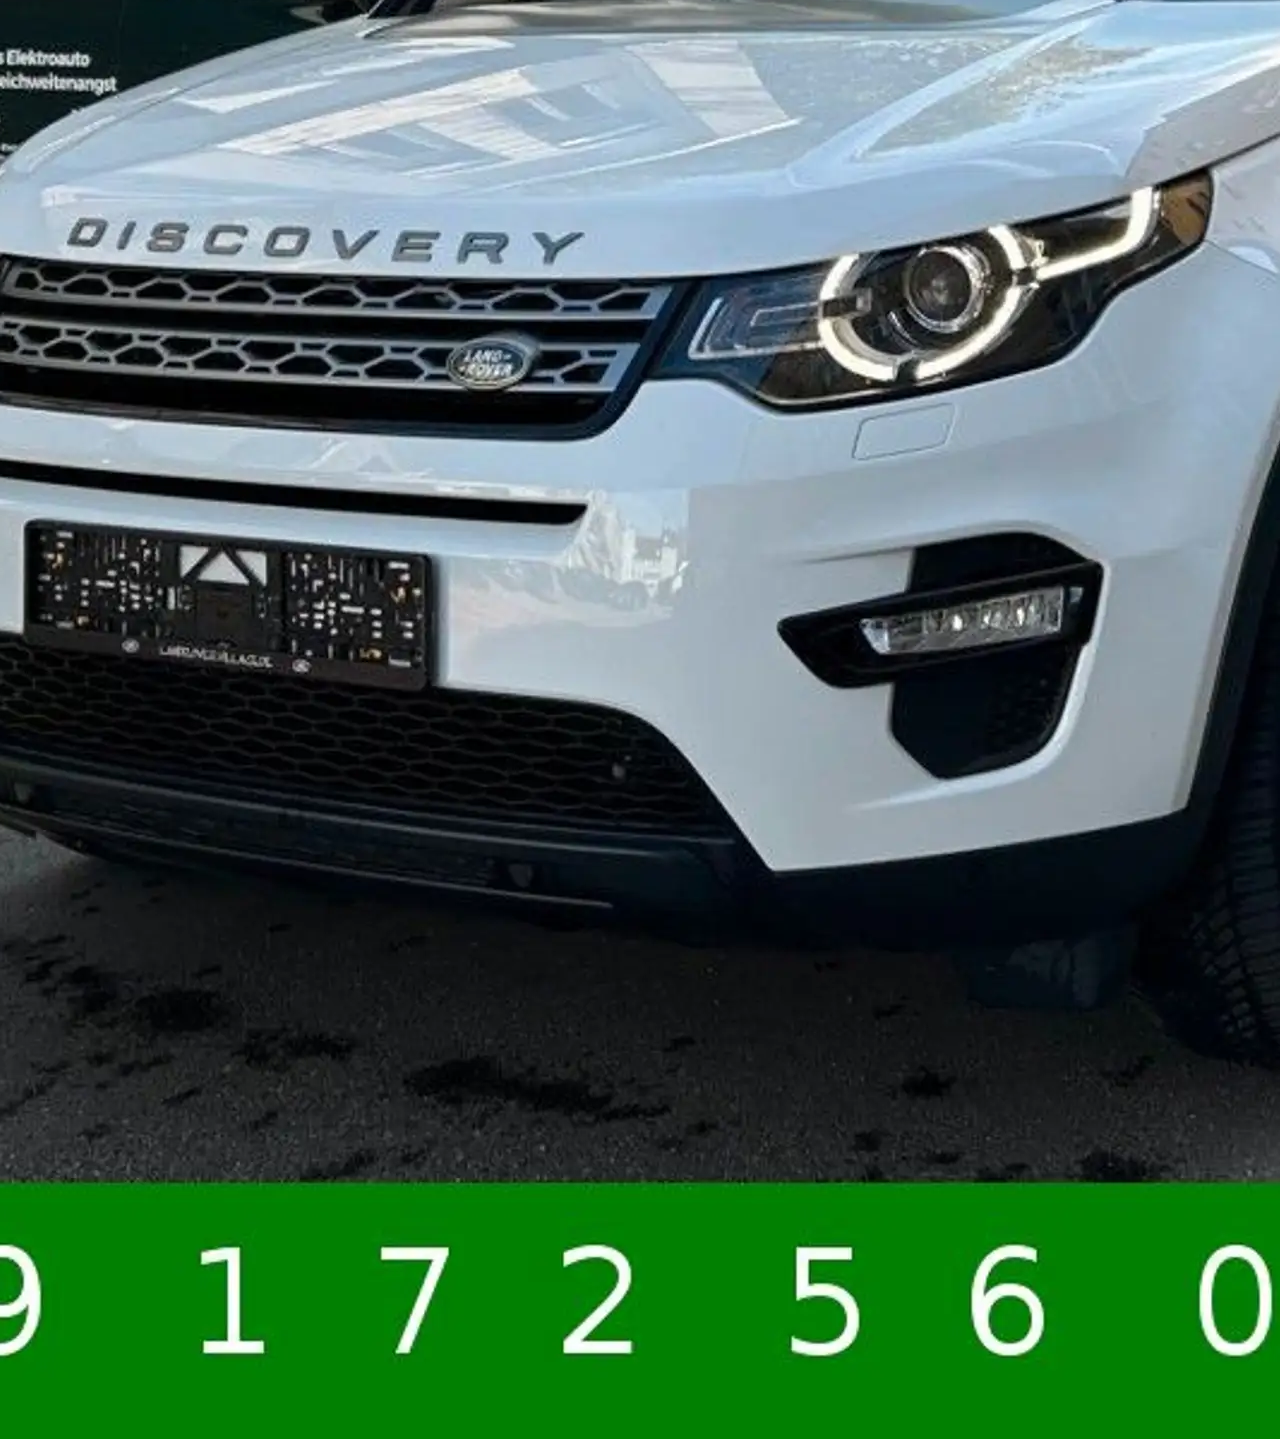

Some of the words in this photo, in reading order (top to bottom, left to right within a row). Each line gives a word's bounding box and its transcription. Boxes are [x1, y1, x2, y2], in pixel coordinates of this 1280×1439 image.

[6, 49, 91, 68] Elektroauto
[66, 217, 585, 266] DISCOVERY
[463, 349, 504, 363] LAND
[465, 363, 513, 378] ROVER
